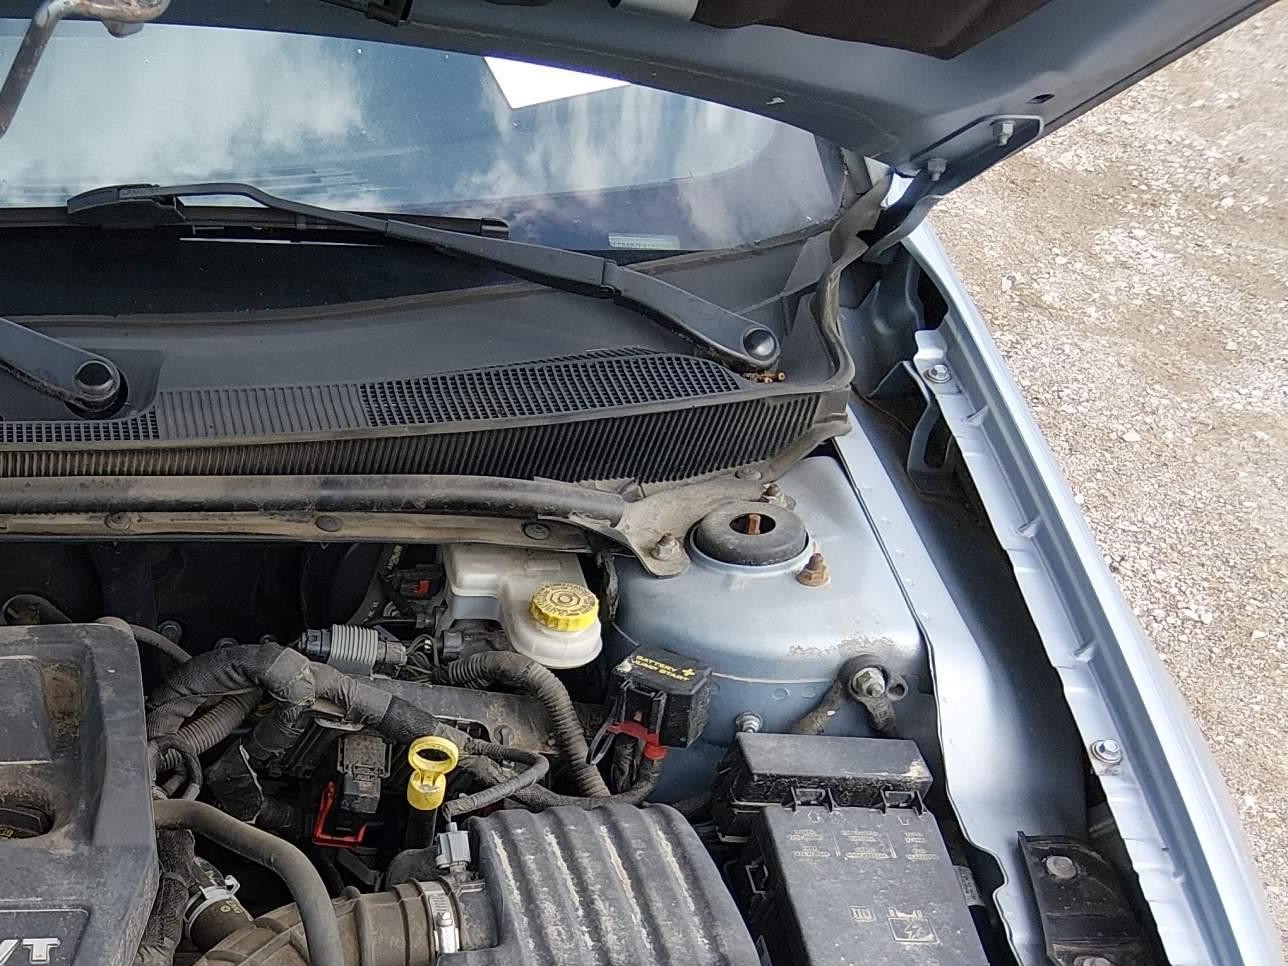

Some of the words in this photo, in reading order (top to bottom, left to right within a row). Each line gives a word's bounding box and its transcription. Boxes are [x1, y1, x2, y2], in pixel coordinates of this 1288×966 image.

[636, 655, 678, 672] BATTERY
[636, 660, 658, 671] JUMP
[659, 669, 690, 681] START
